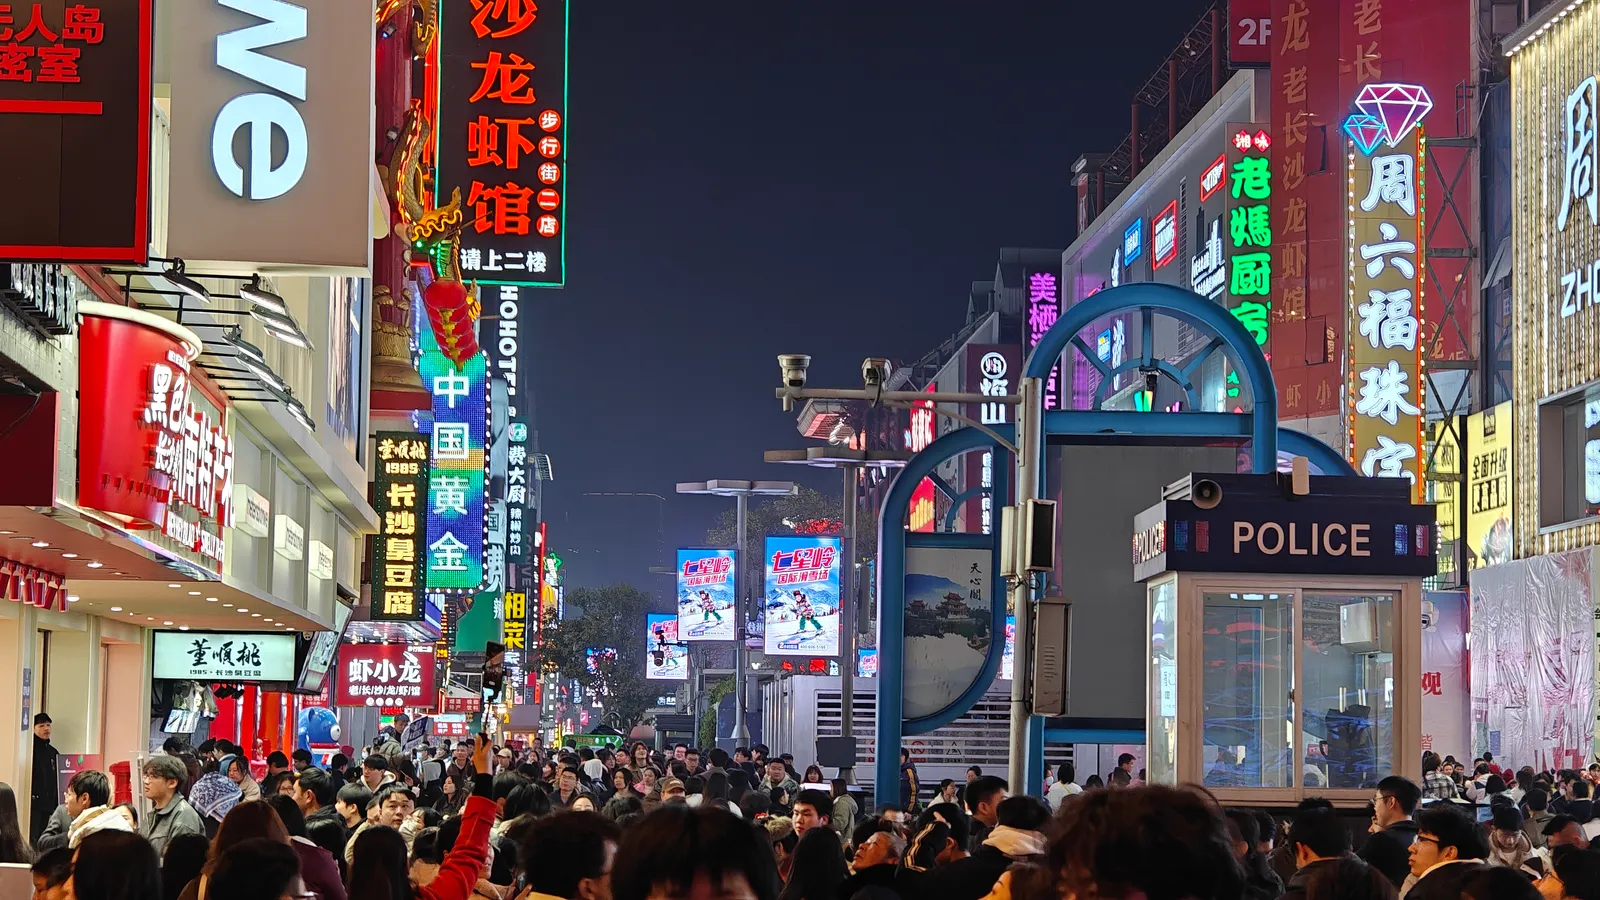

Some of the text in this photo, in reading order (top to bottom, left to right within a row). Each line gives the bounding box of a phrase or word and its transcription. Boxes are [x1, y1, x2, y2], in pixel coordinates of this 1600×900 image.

[0, 44, 81, 83] 密室
[466, 0, 538, 235] 沙龙虾馆
[1235, 133, 1269, 149] 湘味
[1558, 74, 1598, 232] 周
[540, 112, 558, 235] 步行街二店
[460, 249, 547, 273] 请上二楼
[1355, 154, 1421, 486] 周六福珠宝
[385, 462, 419, 475] 1985
[429, 368, 470, 572] 中国黄金
[507, 445, 527, 504] 费大厨
[1472, 447, 1508, 480] 全面升级
[383, 483, 416, 615] 长沙臭豆腐
[1138, 526, 1161, 563] POLICE
[1233, 521, 1371, 556] POLICE
[682, 556, 731, 577] 七星岭
[771, 546, 836, 573] 七星岭
[777, 569, 829, 585] 国际滑雪场
[348, 651, 422, 683] 虾小龙
